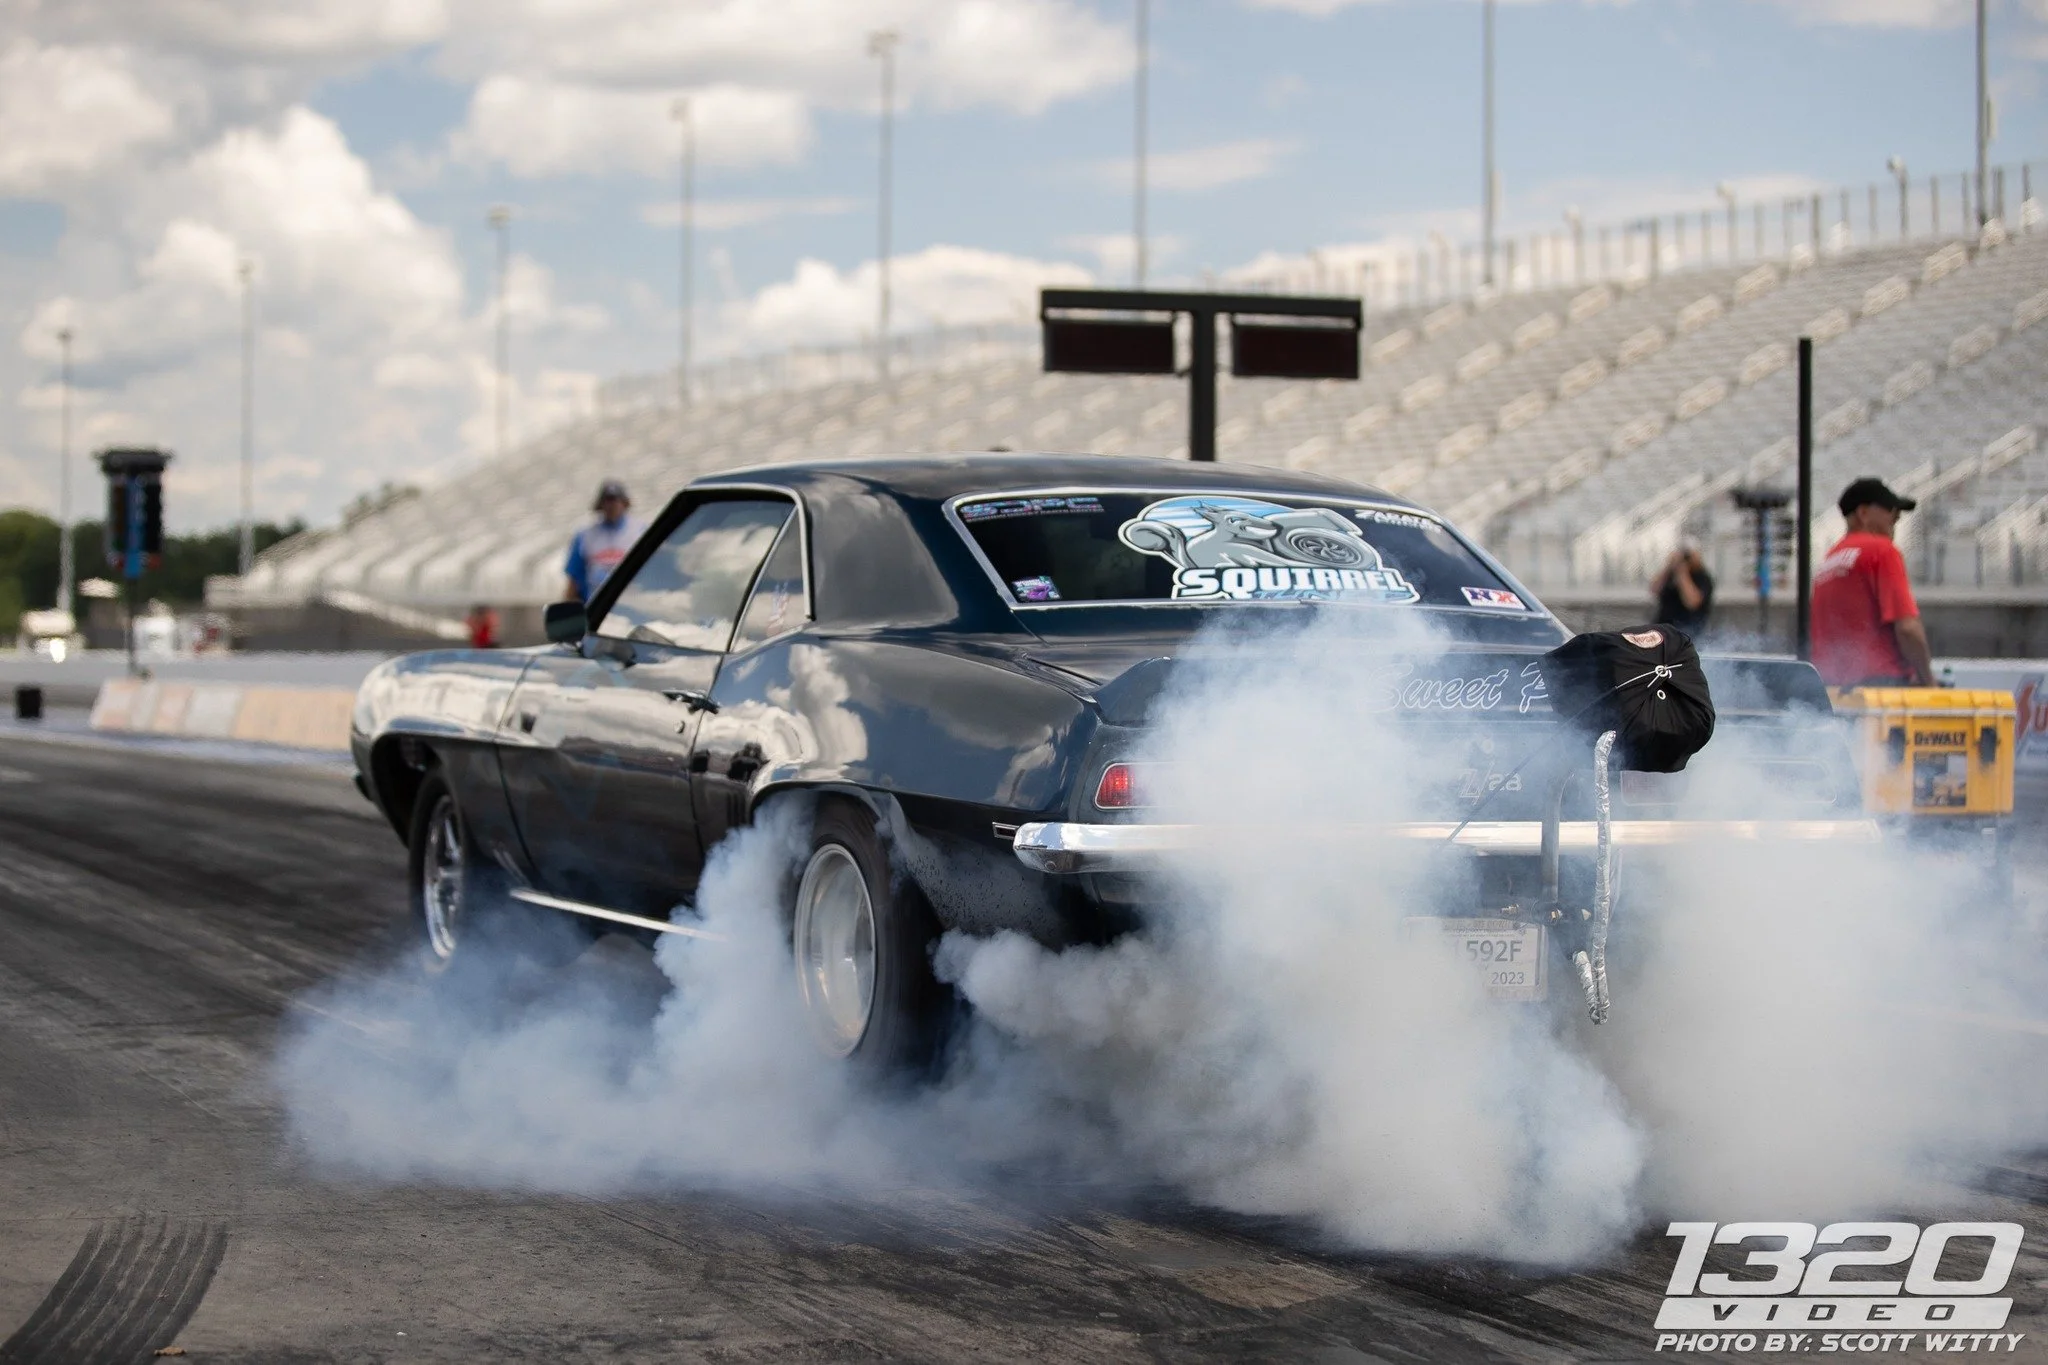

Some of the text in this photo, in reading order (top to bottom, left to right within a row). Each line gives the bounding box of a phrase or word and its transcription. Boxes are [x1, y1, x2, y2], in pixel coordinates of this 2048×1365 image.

[1181, 568, 1408, 600] SQUIRREL
[1366, 662, 1510, 713] Sweet
[1454, 940, 1523, 962] 592F
[1491, 972, 1525, 985] 2023
